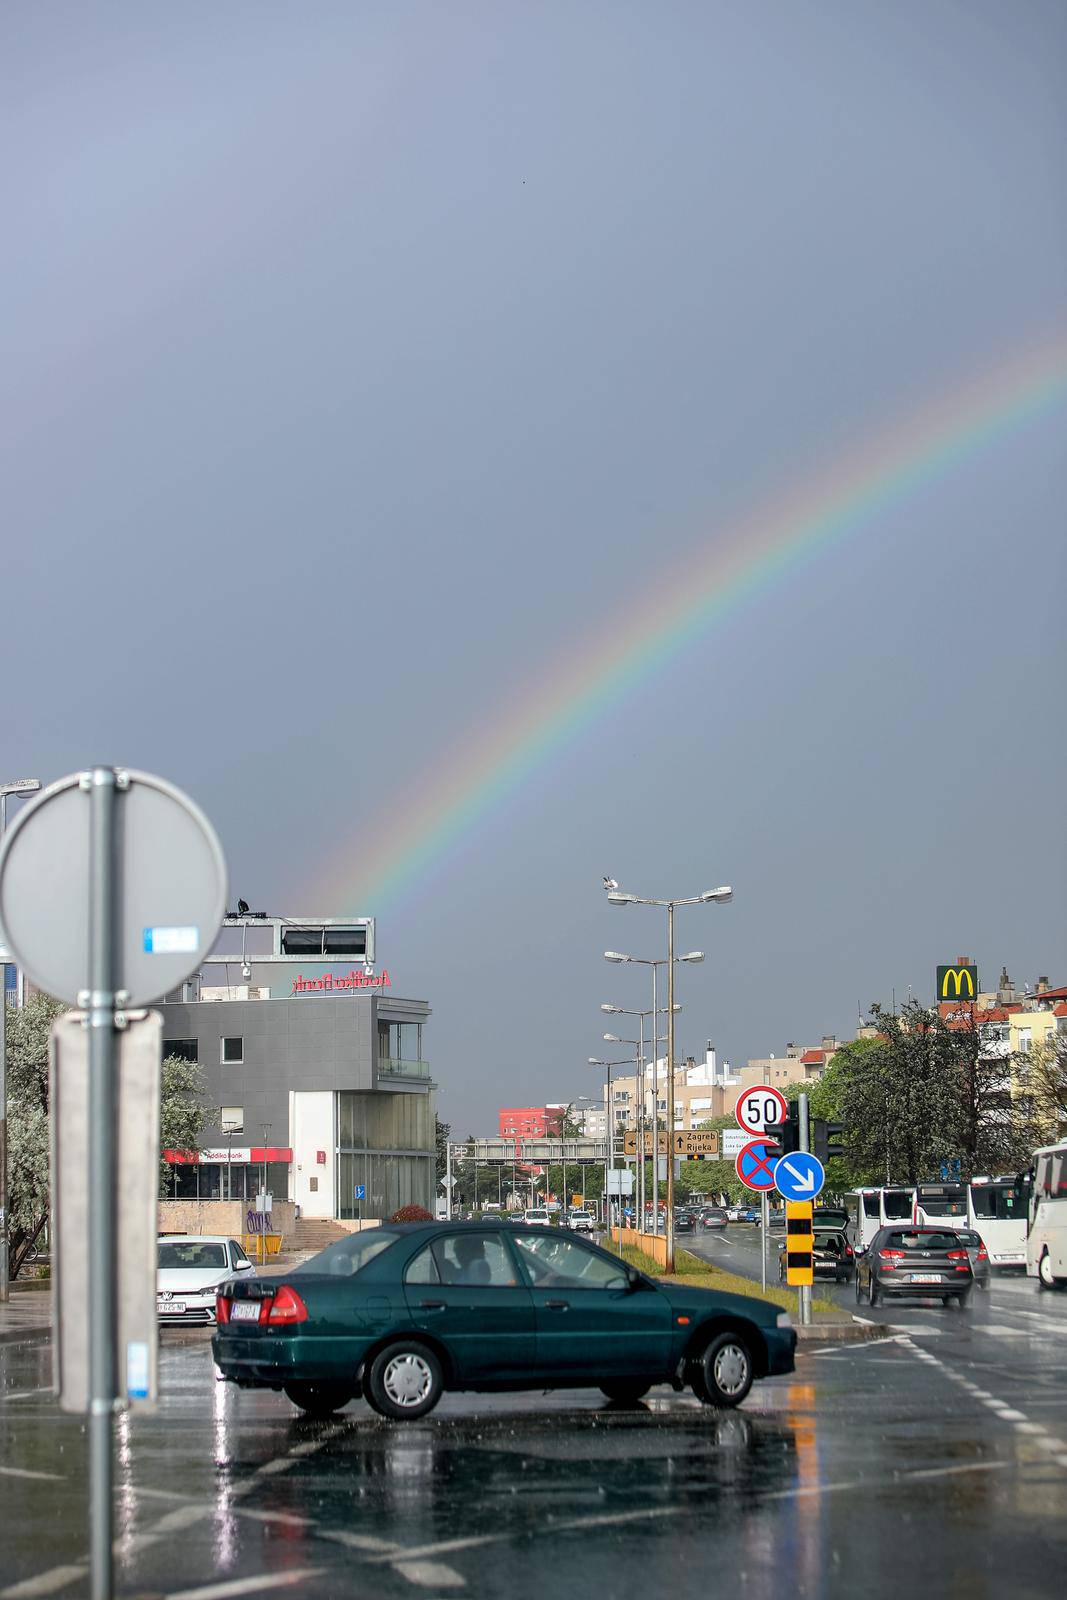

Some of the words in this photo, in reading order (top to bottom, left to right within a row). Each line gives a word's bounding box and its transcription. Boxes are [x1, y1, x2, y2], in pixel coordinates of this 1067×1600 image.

[747, 1098, 777, 1124] 50
[686, 1132, 716, 1142] Zagreb
[686, 1143, 712, 1153] Rijeka
